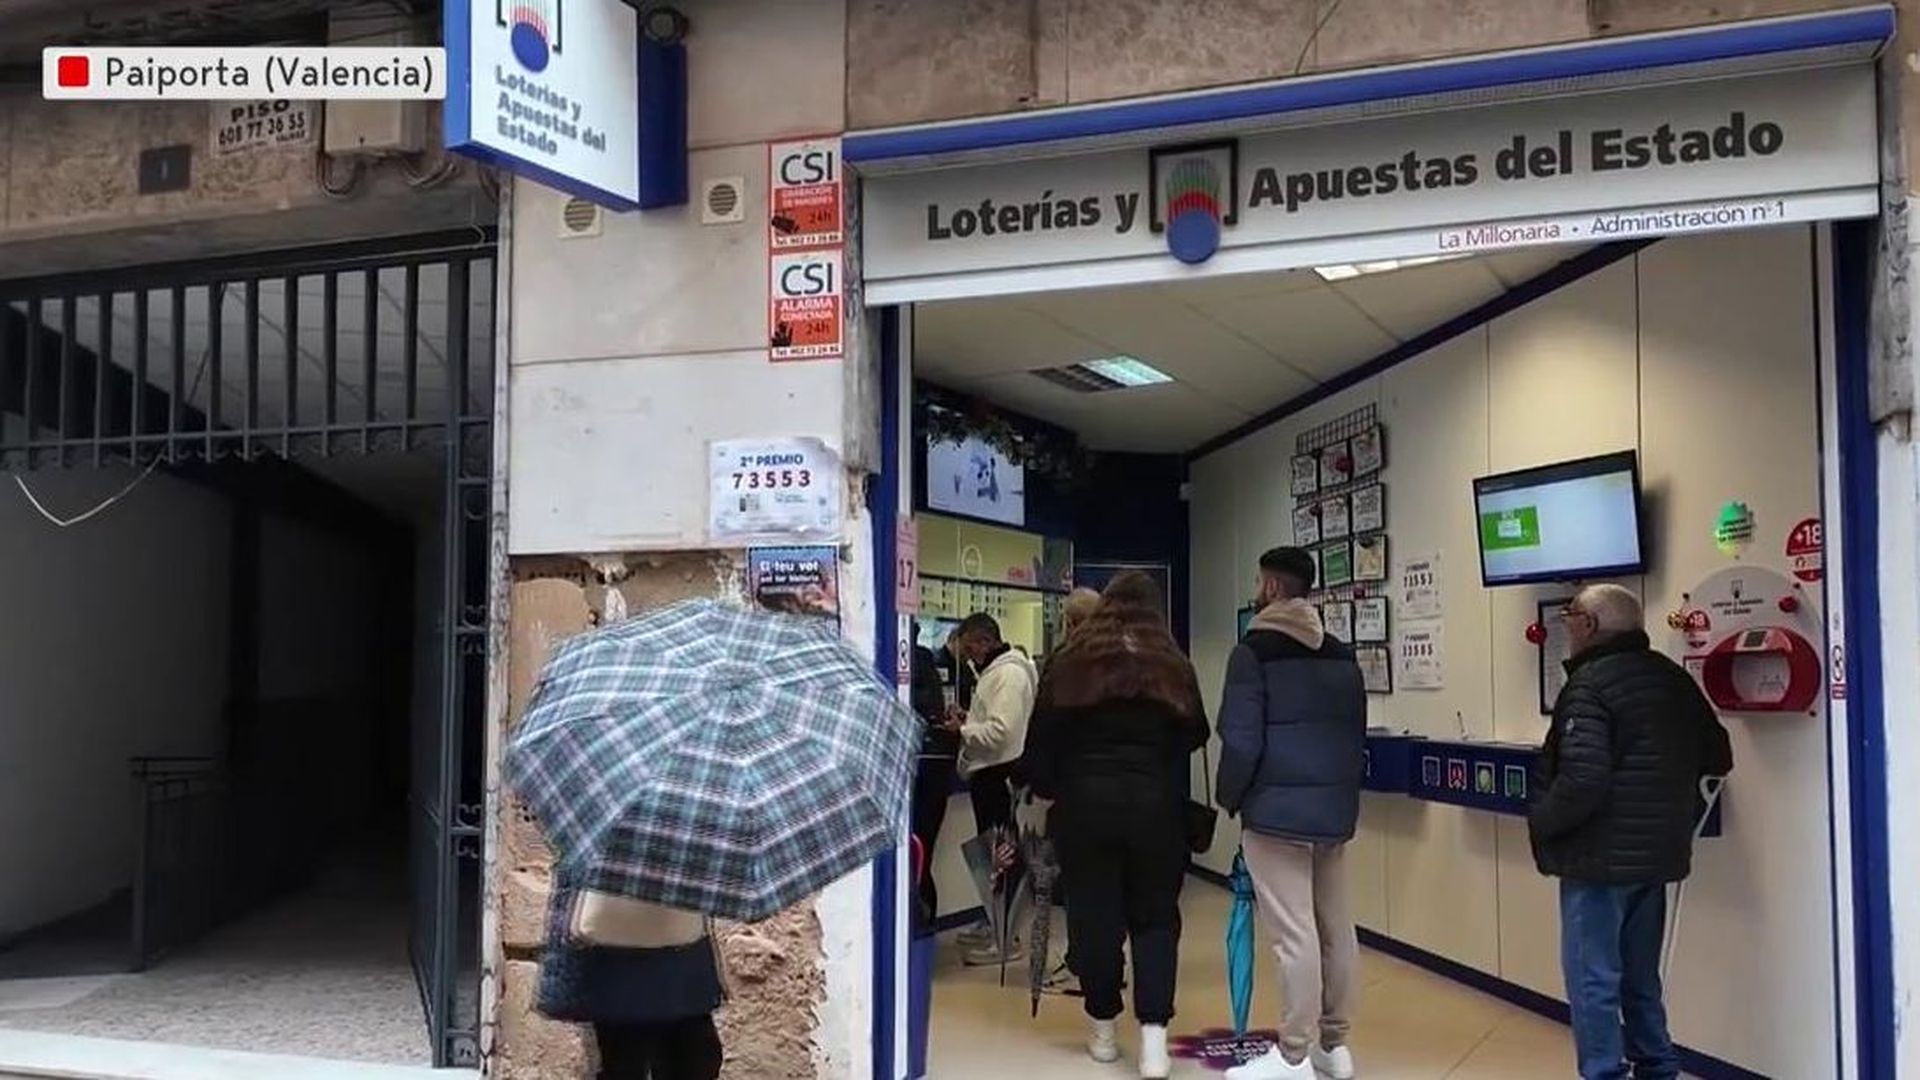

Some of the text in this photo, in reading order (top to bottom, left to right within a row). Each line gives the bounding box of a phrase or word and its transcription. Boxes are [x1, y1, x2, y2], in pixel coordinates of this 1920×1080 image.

[231, 99, 290, 123] PISO
[498, 91, 606, 153] Apuestas del
[571, 101, 581, 122] y
[497, 115, 558, 156] Estado
[781, 151, 833, 185] CSI
[1249, 111, 1784, 212] Apuestas del Estado
[927, 190, 1139, 240] Loterías y
[1438, 232, 1460, 248] La
[1466, 222, 1560, 246] Millonaria
[1591, 205, 1745, 235] Administración
[781, 262, 833, 296] CSI
[780, 299, 834, 311] ALARMA
[756, 454, 804, 466] PREMIO
[732, 470, 810, 489] 73553
[799, 559, 819, 572] vot
[899, 559, 914, 590] 17
